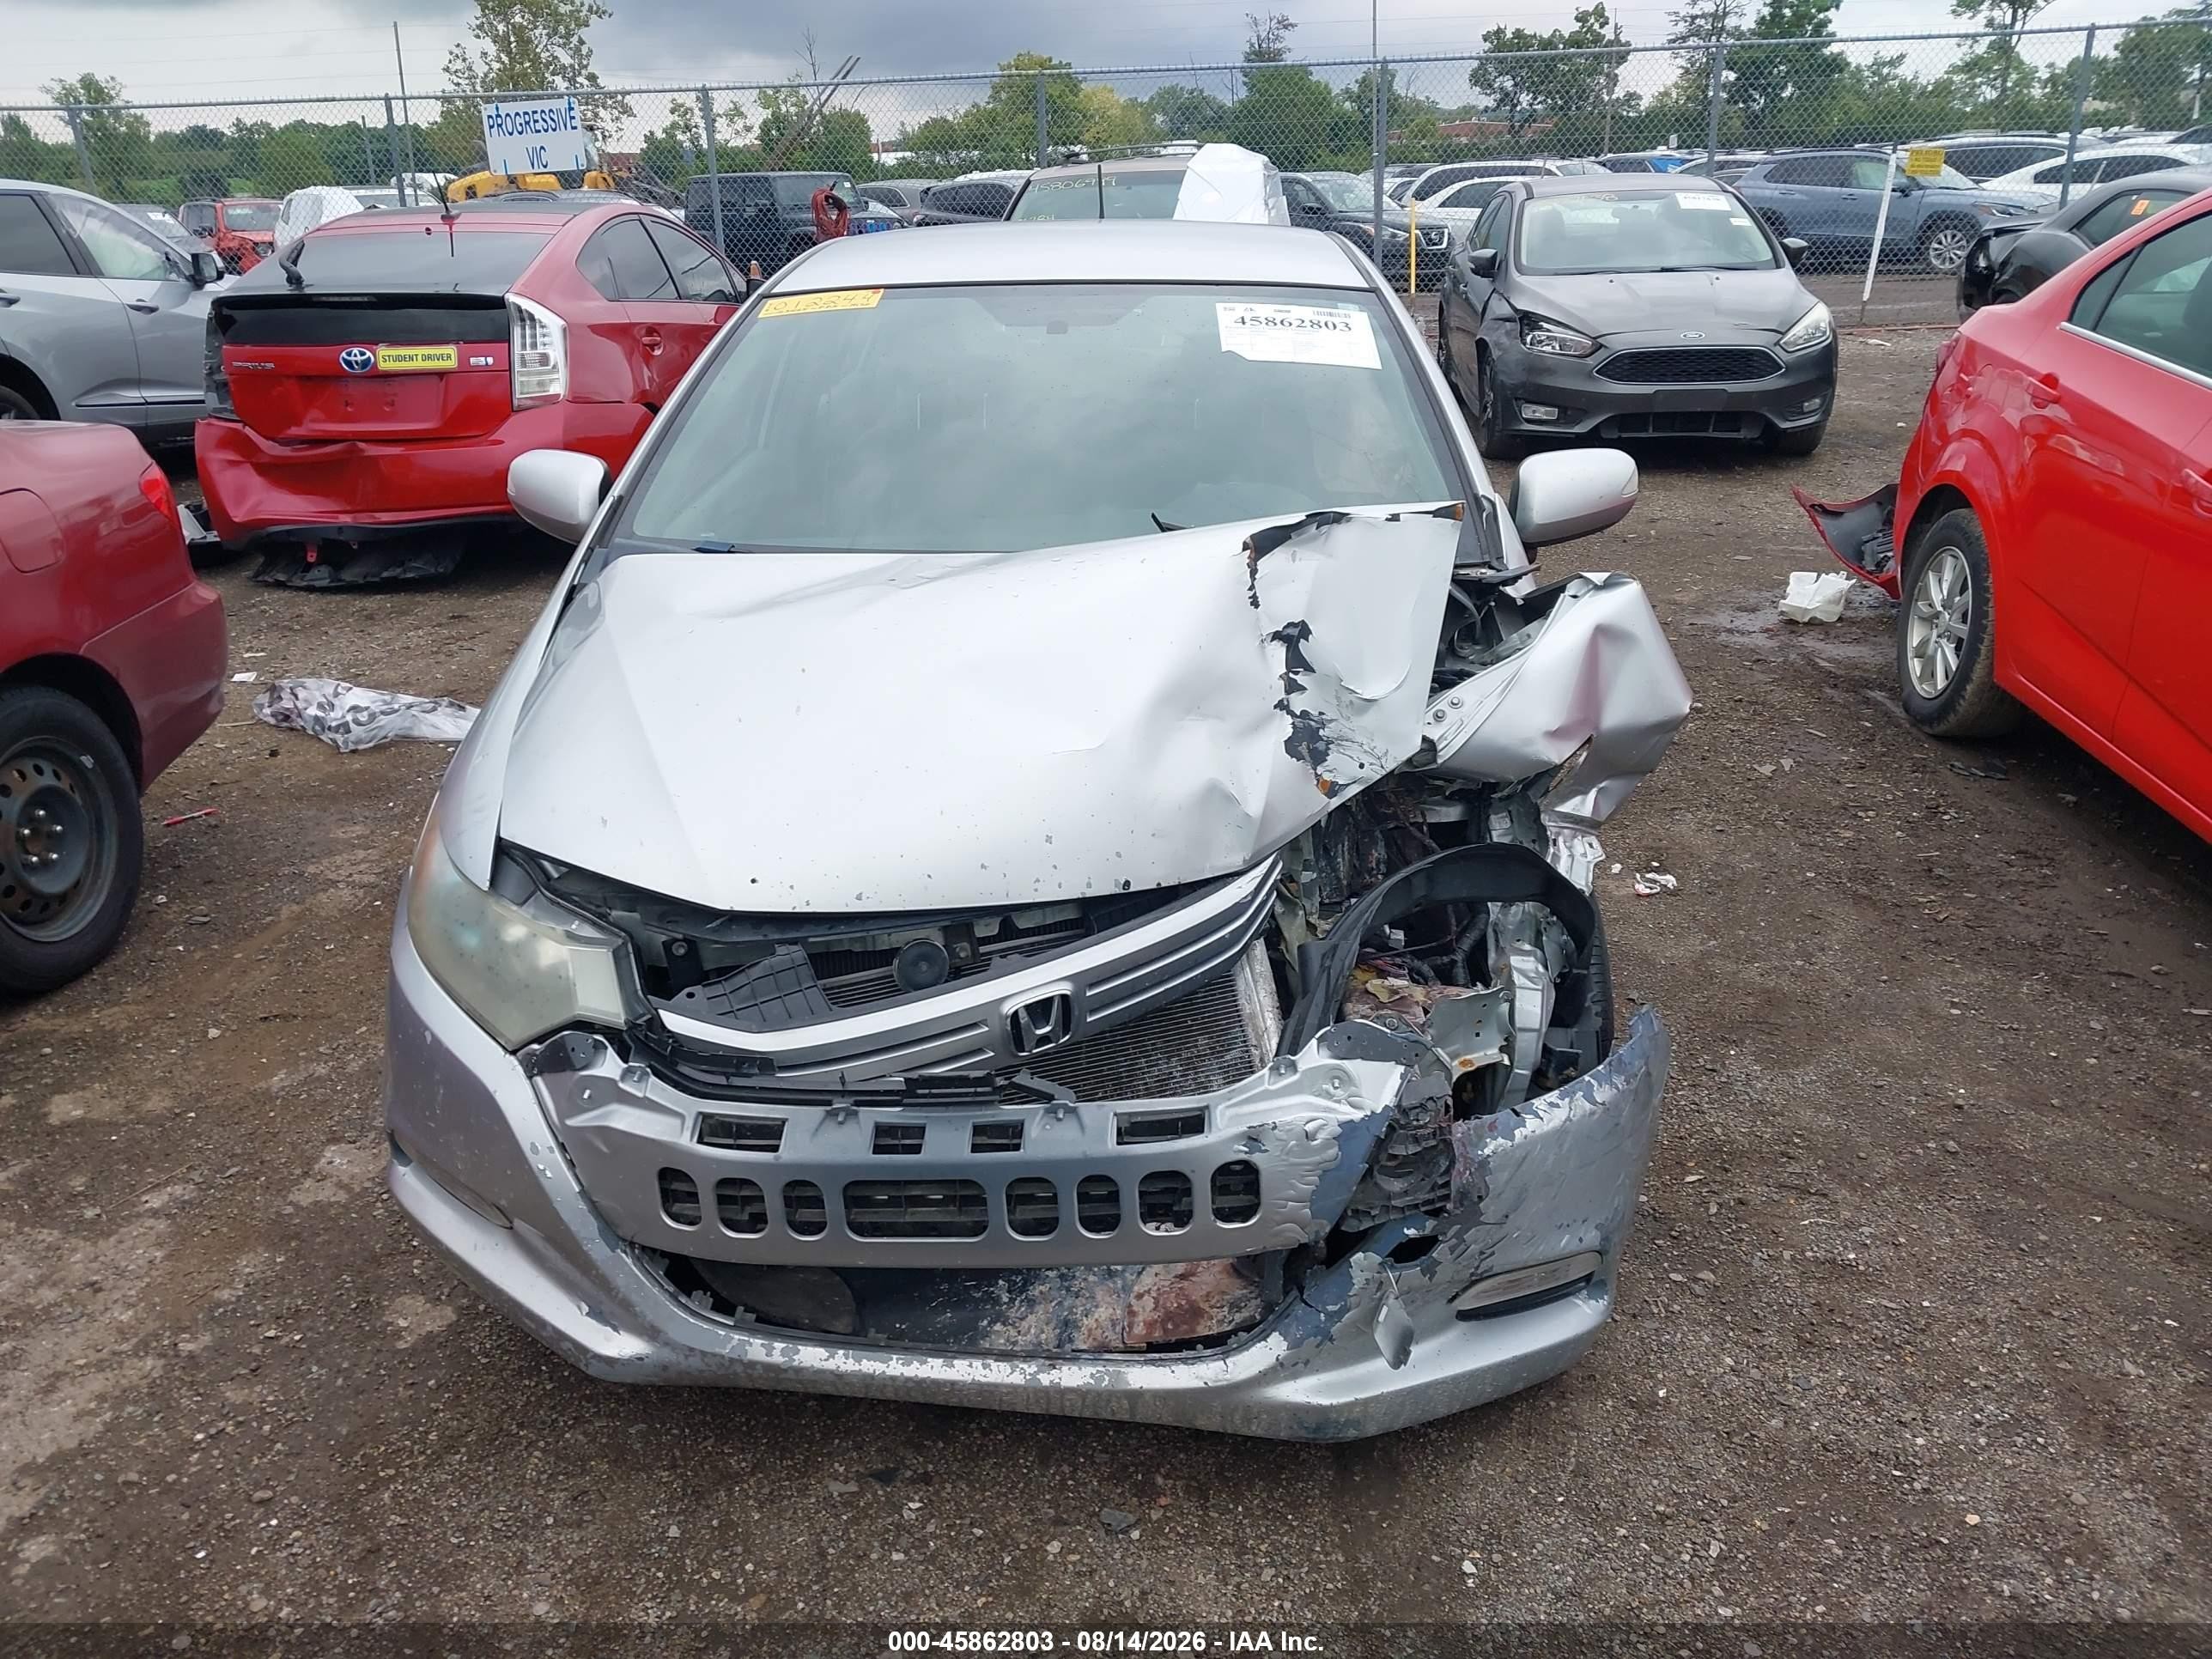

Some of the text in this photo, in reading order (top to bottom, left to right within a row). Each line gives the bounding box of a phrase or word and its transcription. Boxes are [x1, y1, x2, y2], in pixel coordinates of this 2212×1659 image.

[487, 106, 578, 137] PROGRESSIVE
[526, 145, 549, 170] VIC
[1233, 315, 1352, 332] 45862803
[381, 353, 453, 363] STUDENT DRIVER
